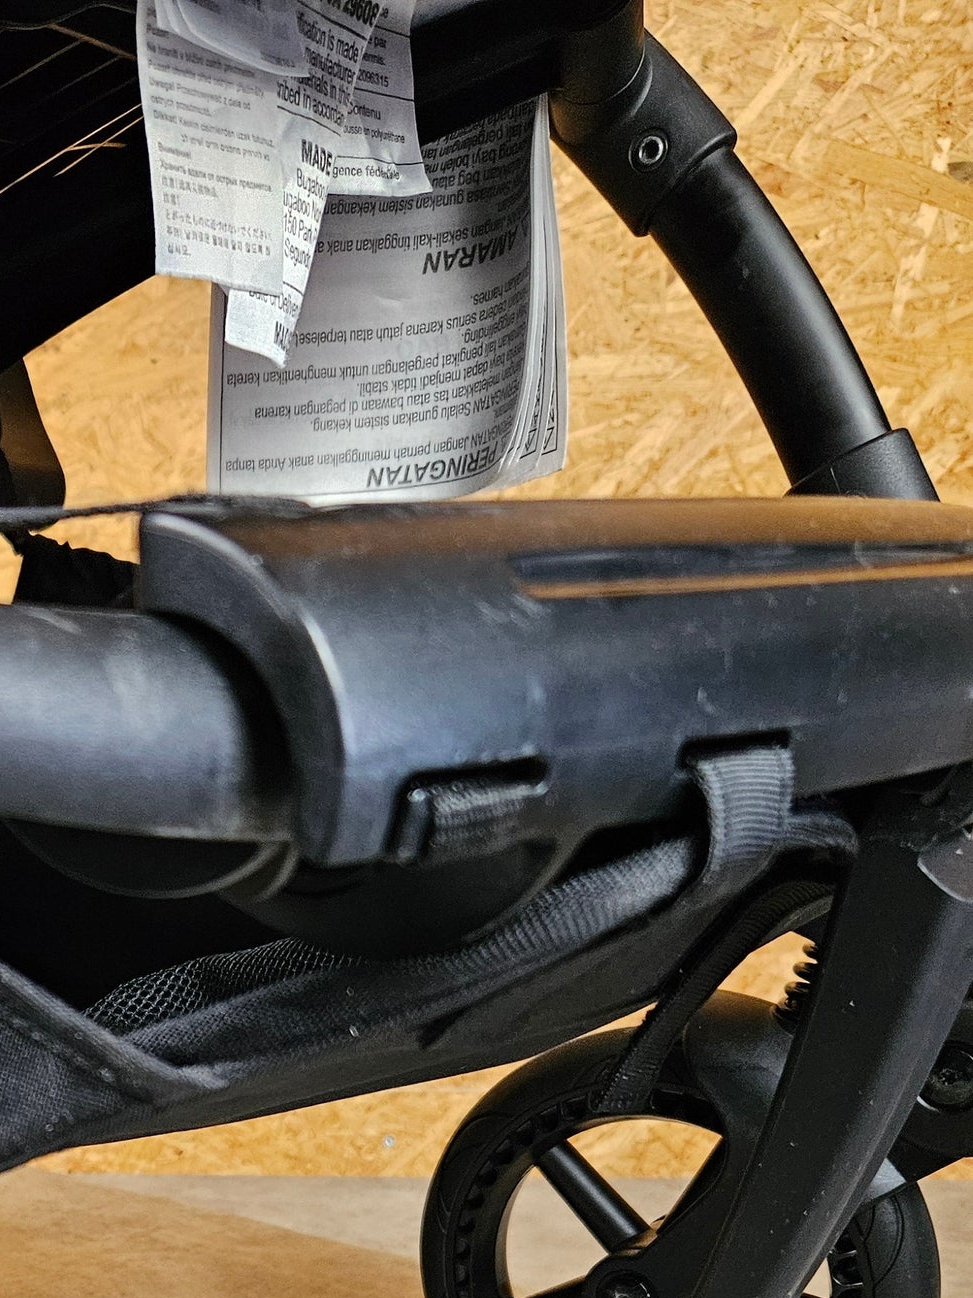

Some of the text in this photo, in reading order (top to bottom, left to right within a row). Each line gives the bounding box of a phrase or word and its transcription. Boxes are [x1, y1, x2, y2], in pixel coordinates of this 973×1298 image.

[343, 124, 362, 135] ousse
[301, 138, 333, 176] MADE
[332, 166, 363, 179] gence
[283, 189, 311, 214] ugaboo
[378, 198, 414, 217] sistem
[415, 189, 465, 214] gunakan
[355, 233, 411, 254] tinggalkan
[412, 228, 469, 248] sekali-kali
[323, 239, 354, 256] anak
[421, 225, 518, 275] AMARAN
[405, 319, 444, 337] karena
[446, 311, 477, 331] serius
[349, 328, 374, 343] atau
[376, 322, 404, 341] jatuh
[441, 345, 483, 367] pengikat
[263, 365, 337, 384] menghentikan
[339, 365, 369, 379] untuk
[371, 355, 439, 377] pergelangan
[463, 360, 488, 379] dapat
[226, 372, 260, 388] kereta
[356, 381, 388, 397] stabil.
[391, 378, 417, 393] tidak
[419, 369, 461, 391] menjadi
[361, 397, 404, 411] bawaan
[407, 394, 431, 407] atau
[433, 390, 449, 403] tas
[254, 405, 291, 419] karena
[293, 399, 346, 416] pegangan
[348, 403, 358, 416] di
[392, 406, 438, 427] gunakan
[440, 401, 471, 419] Selalu
[310, 417, 351, 432] kekang.
[354, 415, 390, 430] sistem
[394, 442, 431, 461] pernah
[433, 436, 469, 455] Jangan
[225, 456, 255, 473] tanpa
[258, 457, 286, 472] Anda
[288, 456, 314, 469] anak
[317, 448, 391, 468] meninggalkan
[366, 442, 498, 488] PERINGATAN
